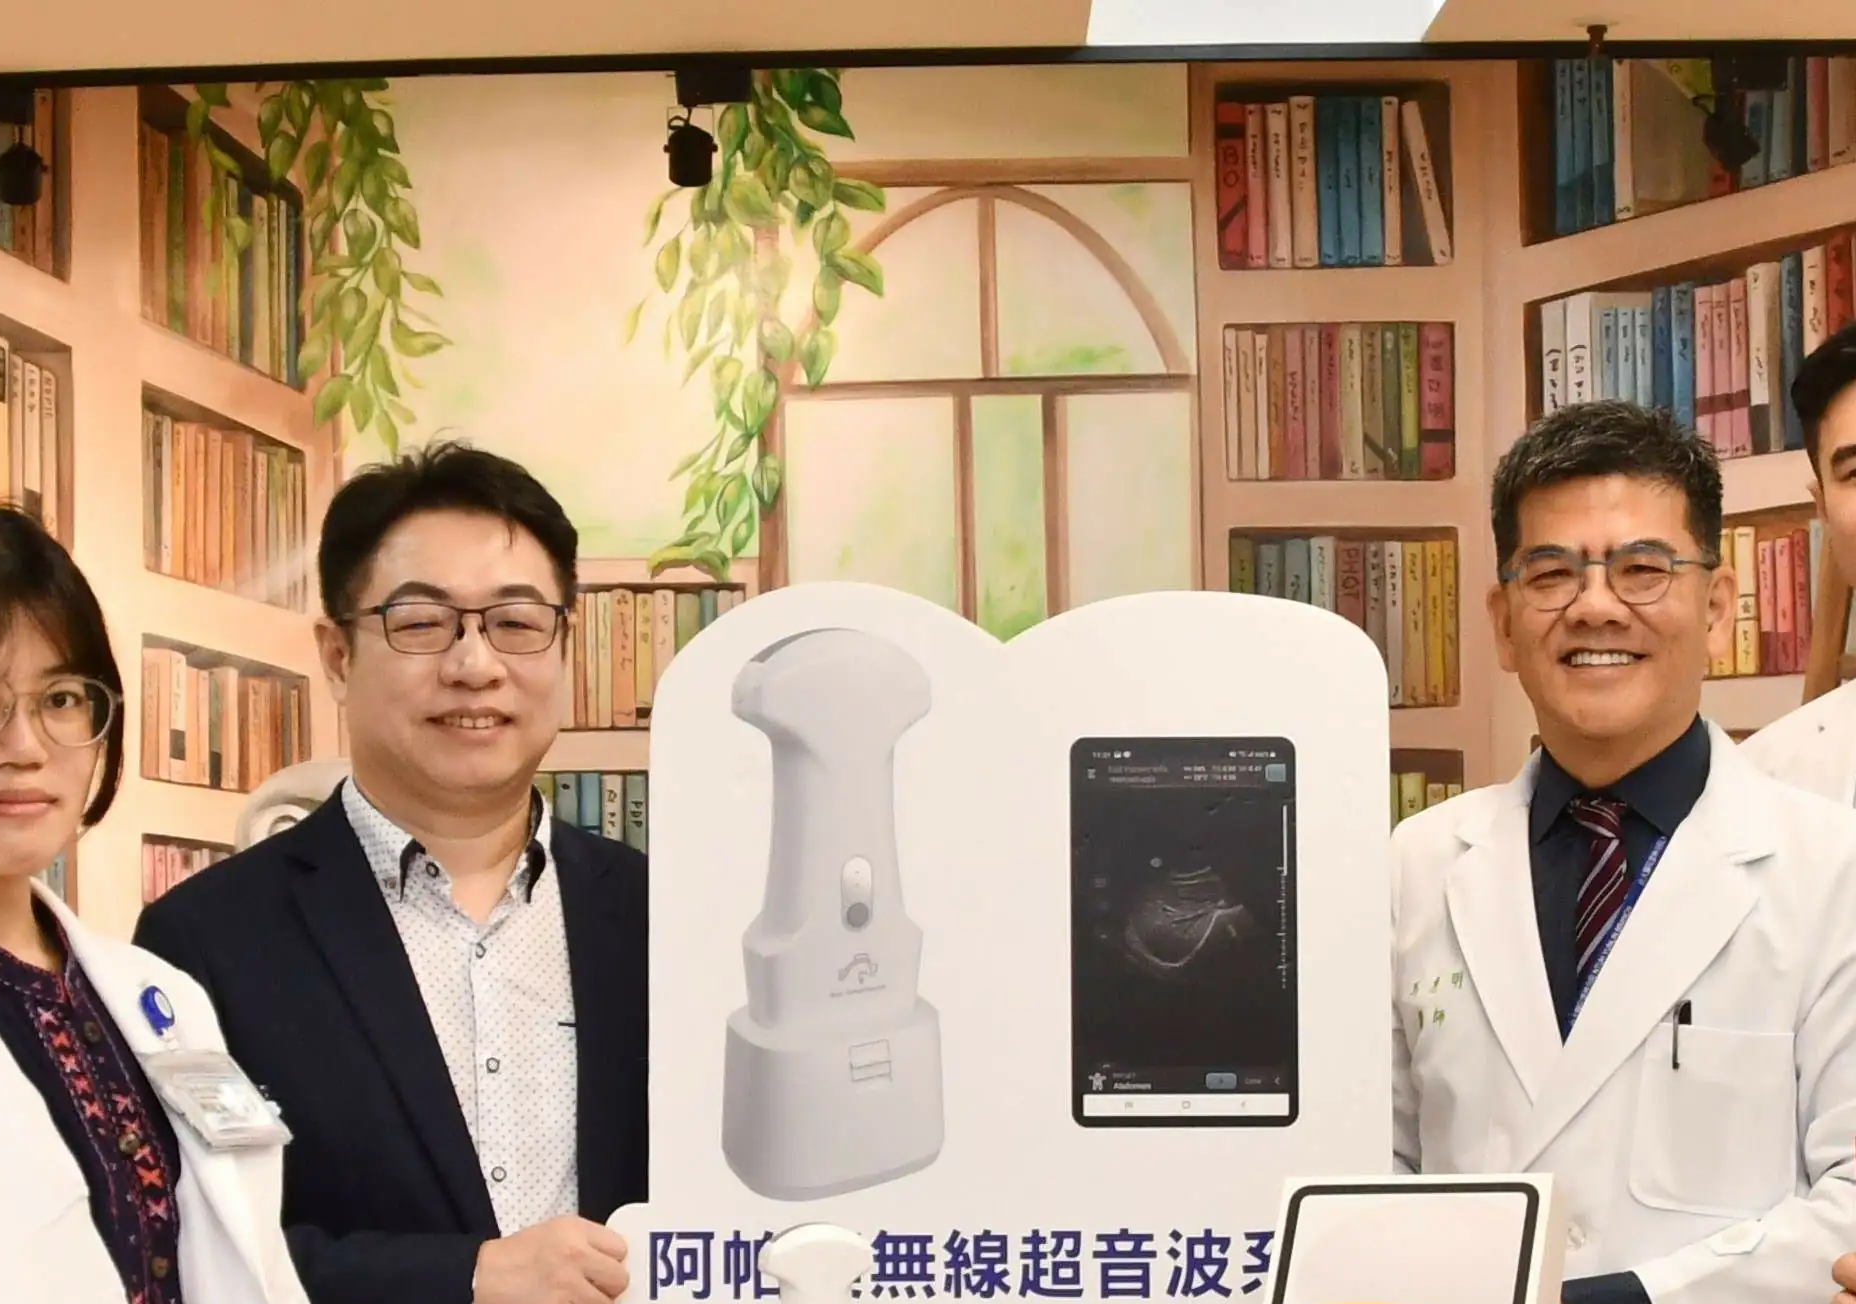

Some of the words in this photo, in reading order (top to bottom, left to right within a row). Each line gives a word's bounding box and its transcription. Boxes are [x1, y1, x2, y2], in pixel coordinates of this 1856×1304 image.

[648, 1228, 1276, 1300] 阿帕無線超音波
